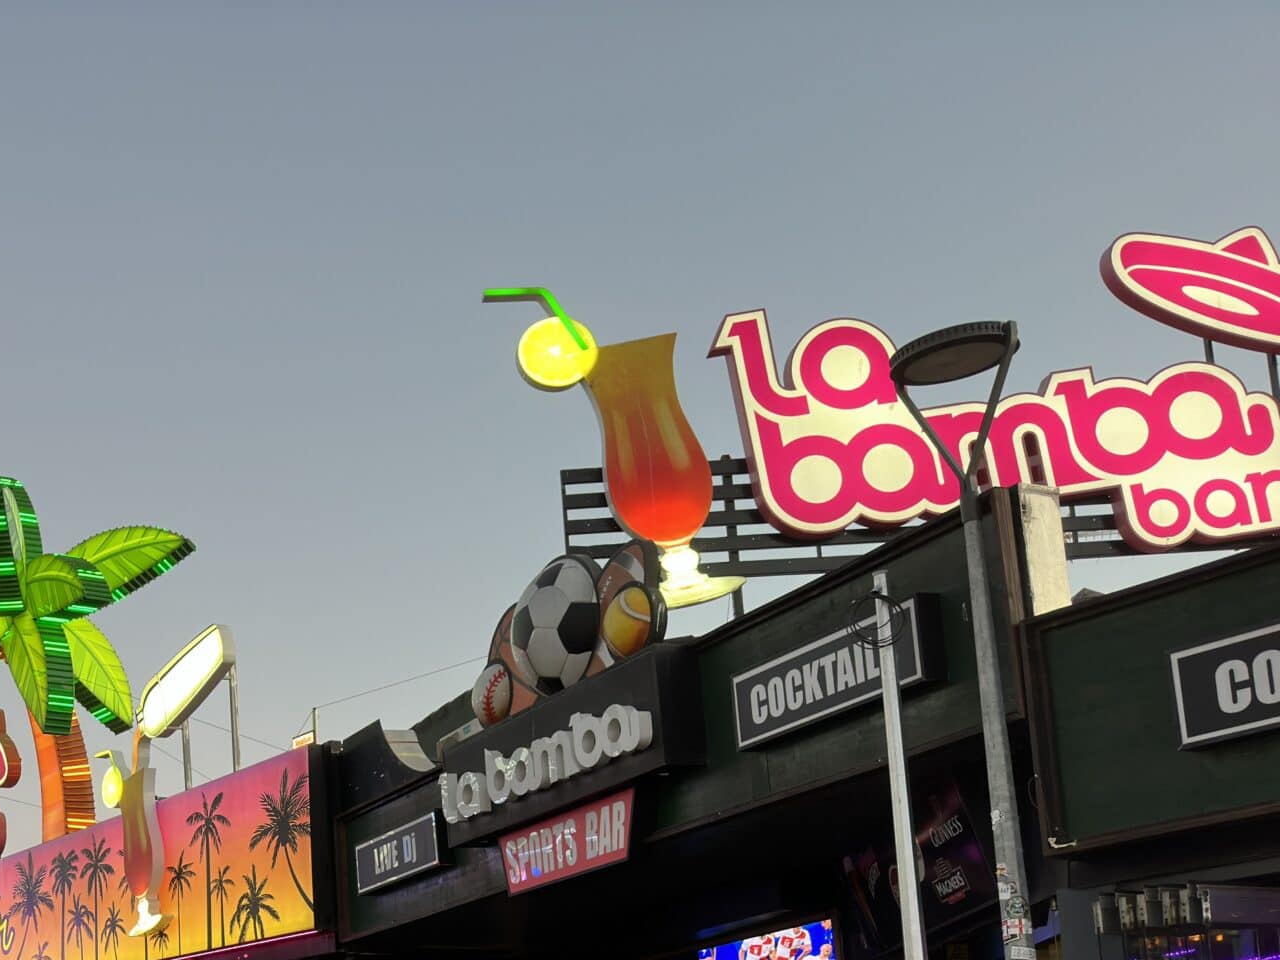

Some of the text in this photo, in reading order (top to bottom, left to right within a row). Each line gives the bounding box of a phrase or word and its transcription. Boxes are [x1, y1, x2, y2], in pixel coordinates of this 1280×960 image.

[727, 318, 900, 417] la
[754, 371, 1276, 525] bamba
[1128, 470, 1280, 538] bar
[484, 703, 653, 805] bamba
[373, 839, 399, 875] LIVE
[505, 800, 626, 885] SPORTS BAR
[929, 815, 964, 848] GUINNESS
